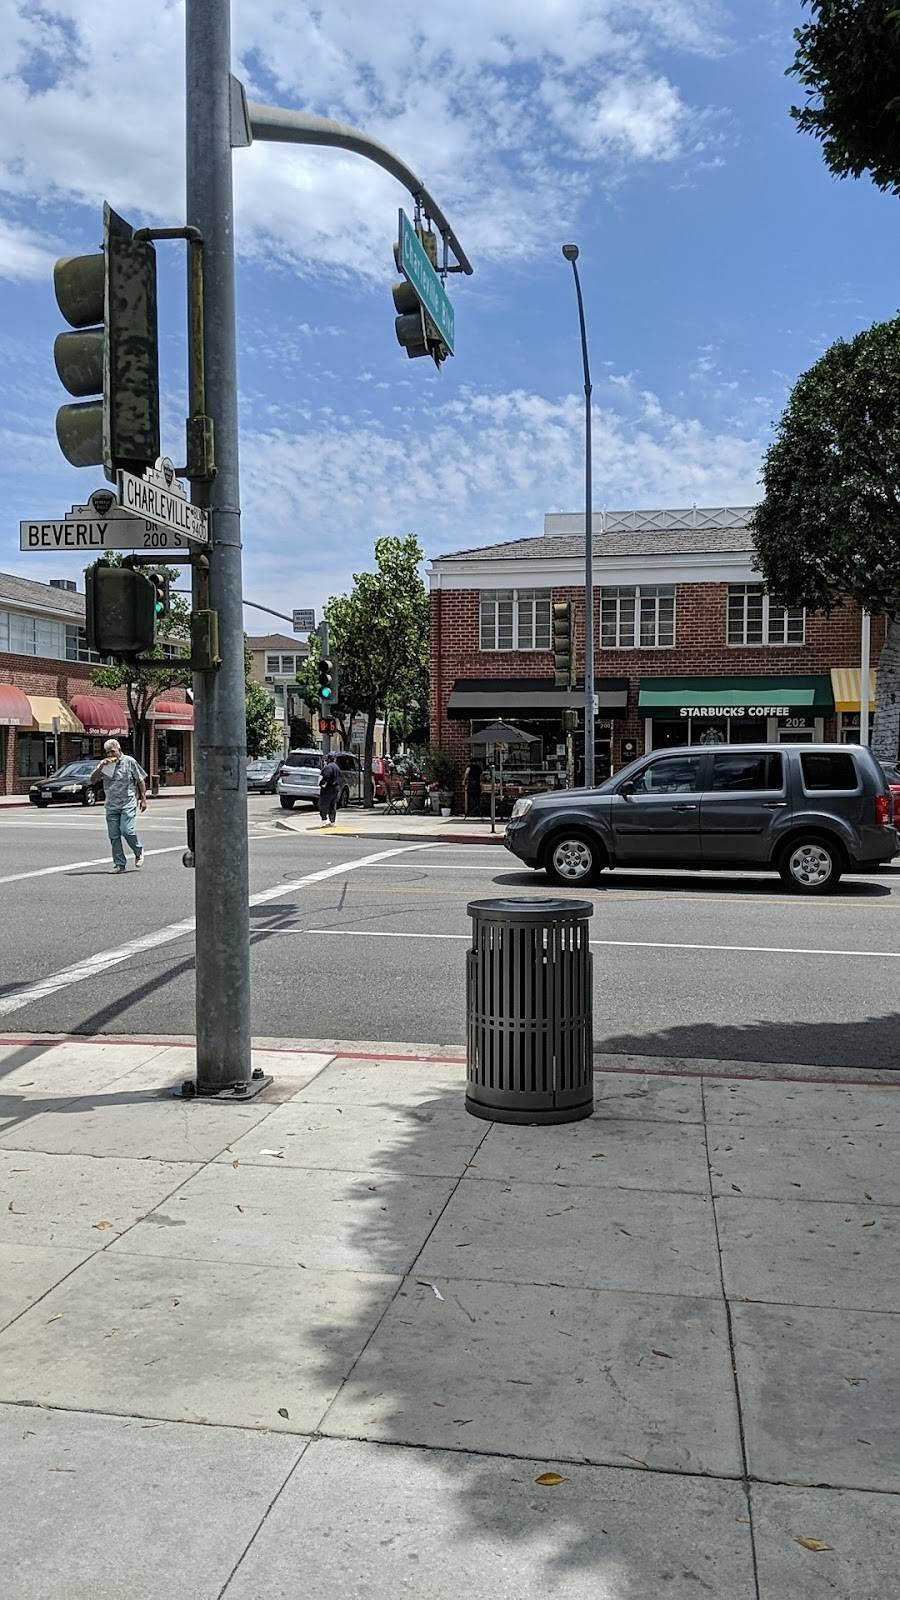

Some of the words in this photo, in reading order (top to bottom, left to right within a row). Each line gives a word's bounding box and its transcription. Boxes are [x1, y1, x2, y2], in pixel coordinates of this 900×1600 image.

[404, 231, 439, 313] Charleville
[127, 478, 190, 530] CHARLEVILLE
[28, 523, 108, 546] BEVERLY
[145, 520, 158, 531] DR
[143, 533, 167, 547] 200
[174, 533, 182, 546] S
[192, 520, 206, 540] 9400
[679, 706, 745, 717] STARBUCKS
[748, 706, 790, 717] COFFEE
[785, 718, 806, 728] 202
